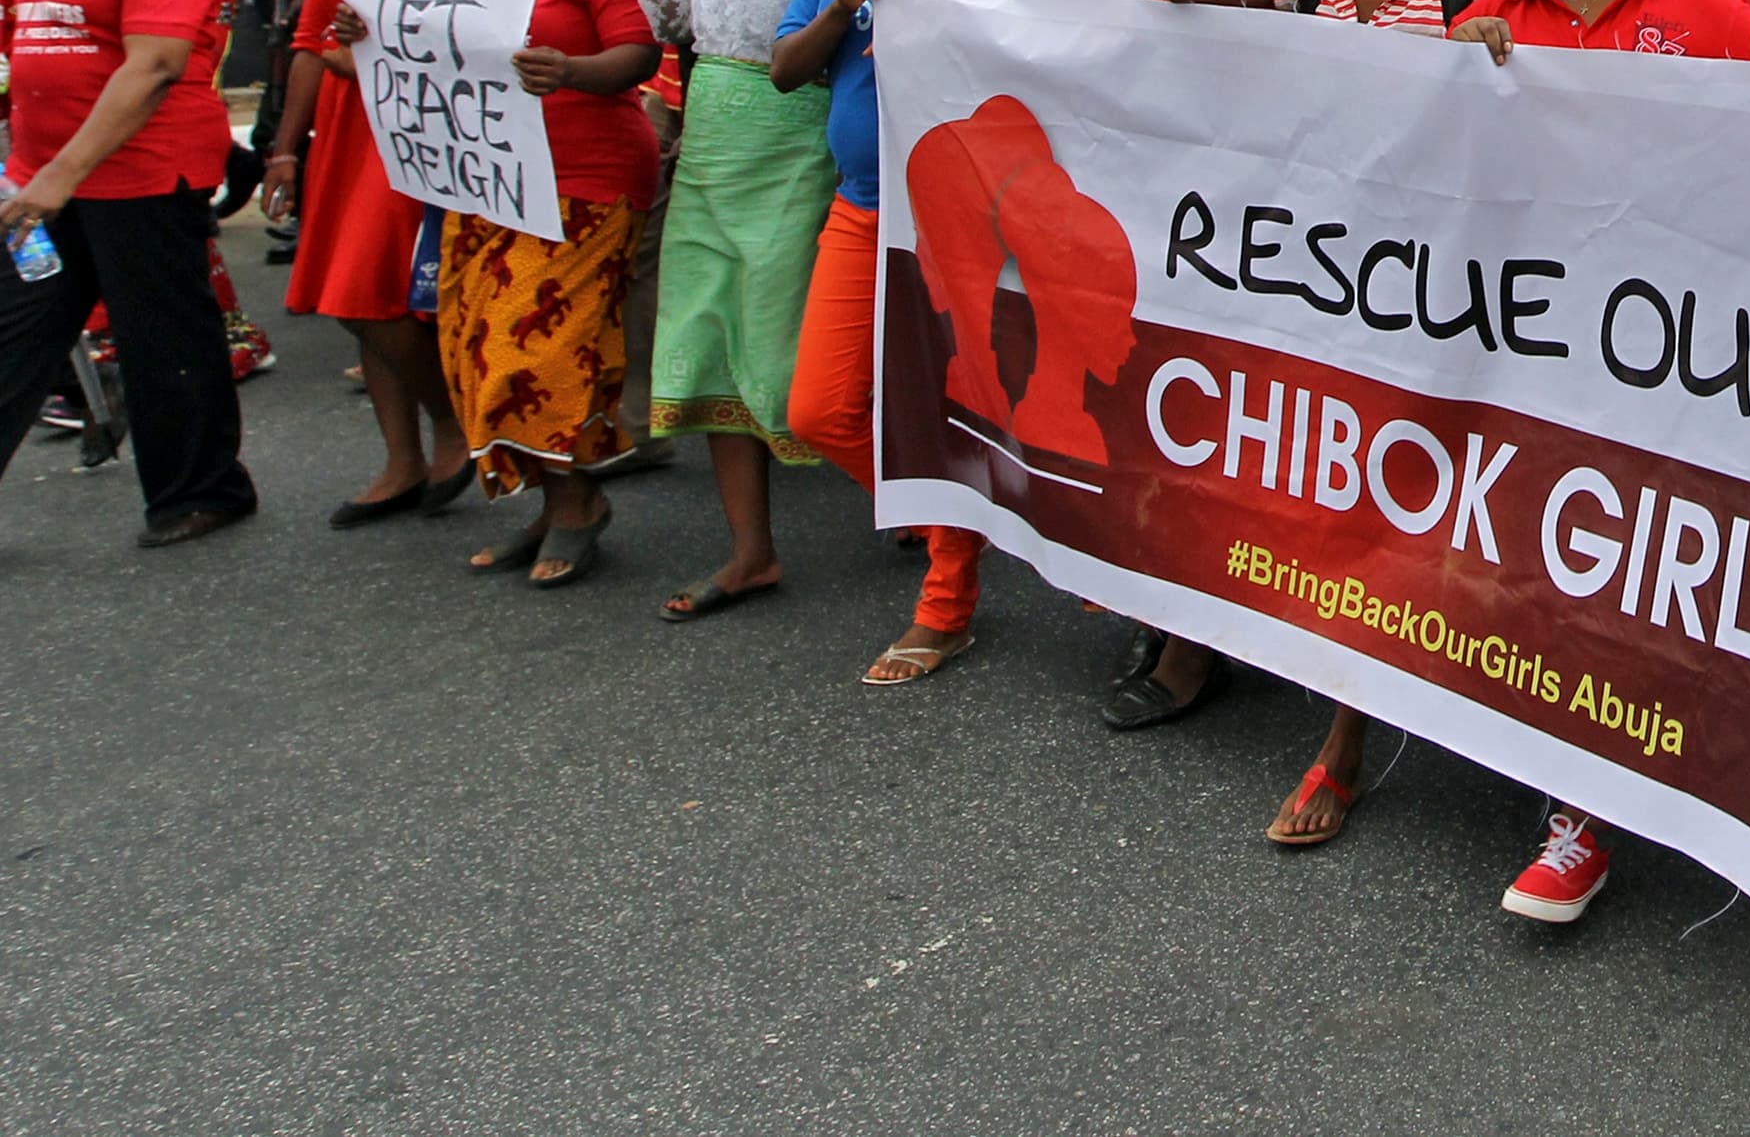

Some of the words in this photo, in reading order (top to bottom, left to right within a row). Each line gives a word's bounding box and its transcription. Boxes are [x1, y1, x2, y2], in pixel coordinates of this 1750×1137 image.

[374, 58, 512, 152] PEACE
[390, 131, 526, 220] REIGN
[1166, 190, 1569, 357] RESCUE
[1145, 357, 1518, 566] CHIBOK
[1227, 539, 1562, 707] #BringBackOurGirls
[1567, 675, 1685, 756] Abuja
